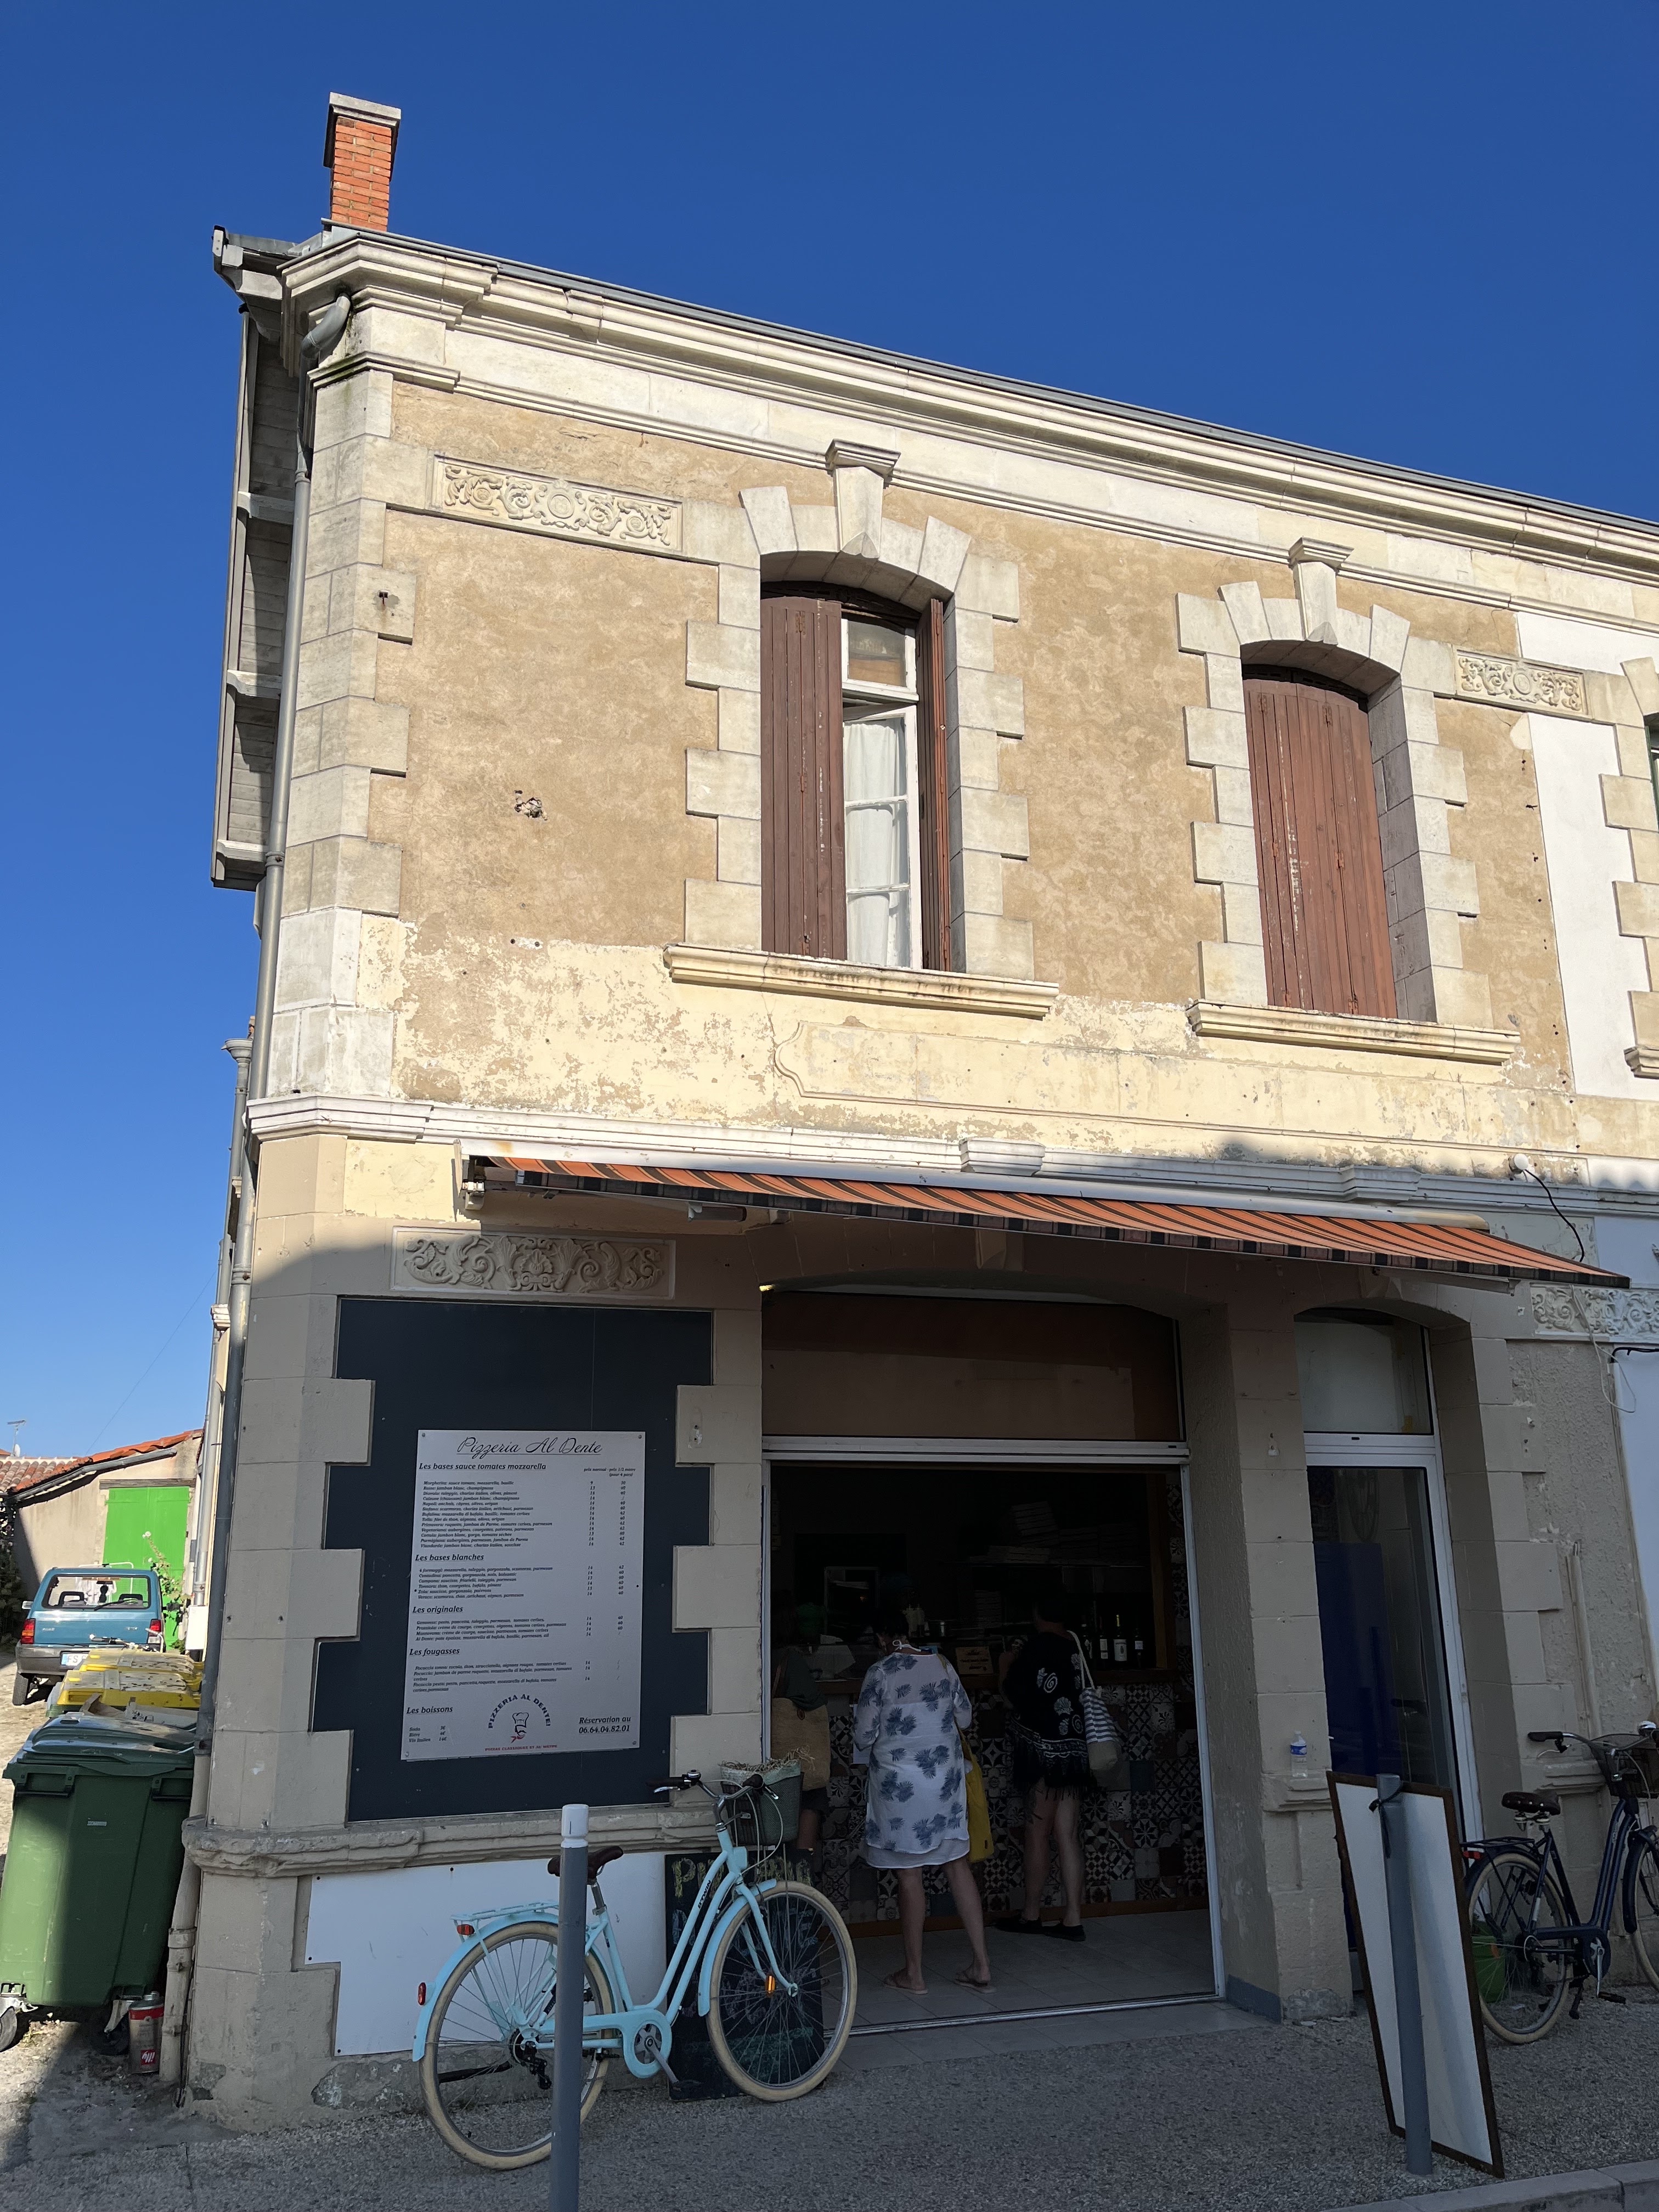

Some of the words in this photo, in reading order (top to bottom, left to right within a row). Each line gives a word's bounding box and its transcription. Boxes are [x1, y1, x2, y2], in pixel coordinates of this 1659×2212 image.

[457, 1437, 521, 1459] Pizzeria
[525, 1437, 554, 1453] Al
[558, 1438, 602, 1453] Dente
[507, 1463, 546, 1471] mozzarella
[452, 1554, 484, 1562] blanches
[427, 1605, 464, 1615] originales
[422, 1648, 460, 1657] fougasses
[421, 1706, 453, 1714] boissons
[488, 1695, 518, 1729] PIZZERIA
[579, 1716, 620, 1725] Réservation
[579, 1725, 630, 1734] 06.64.04.82.01
[142, 2051, 155, 2063] illy
